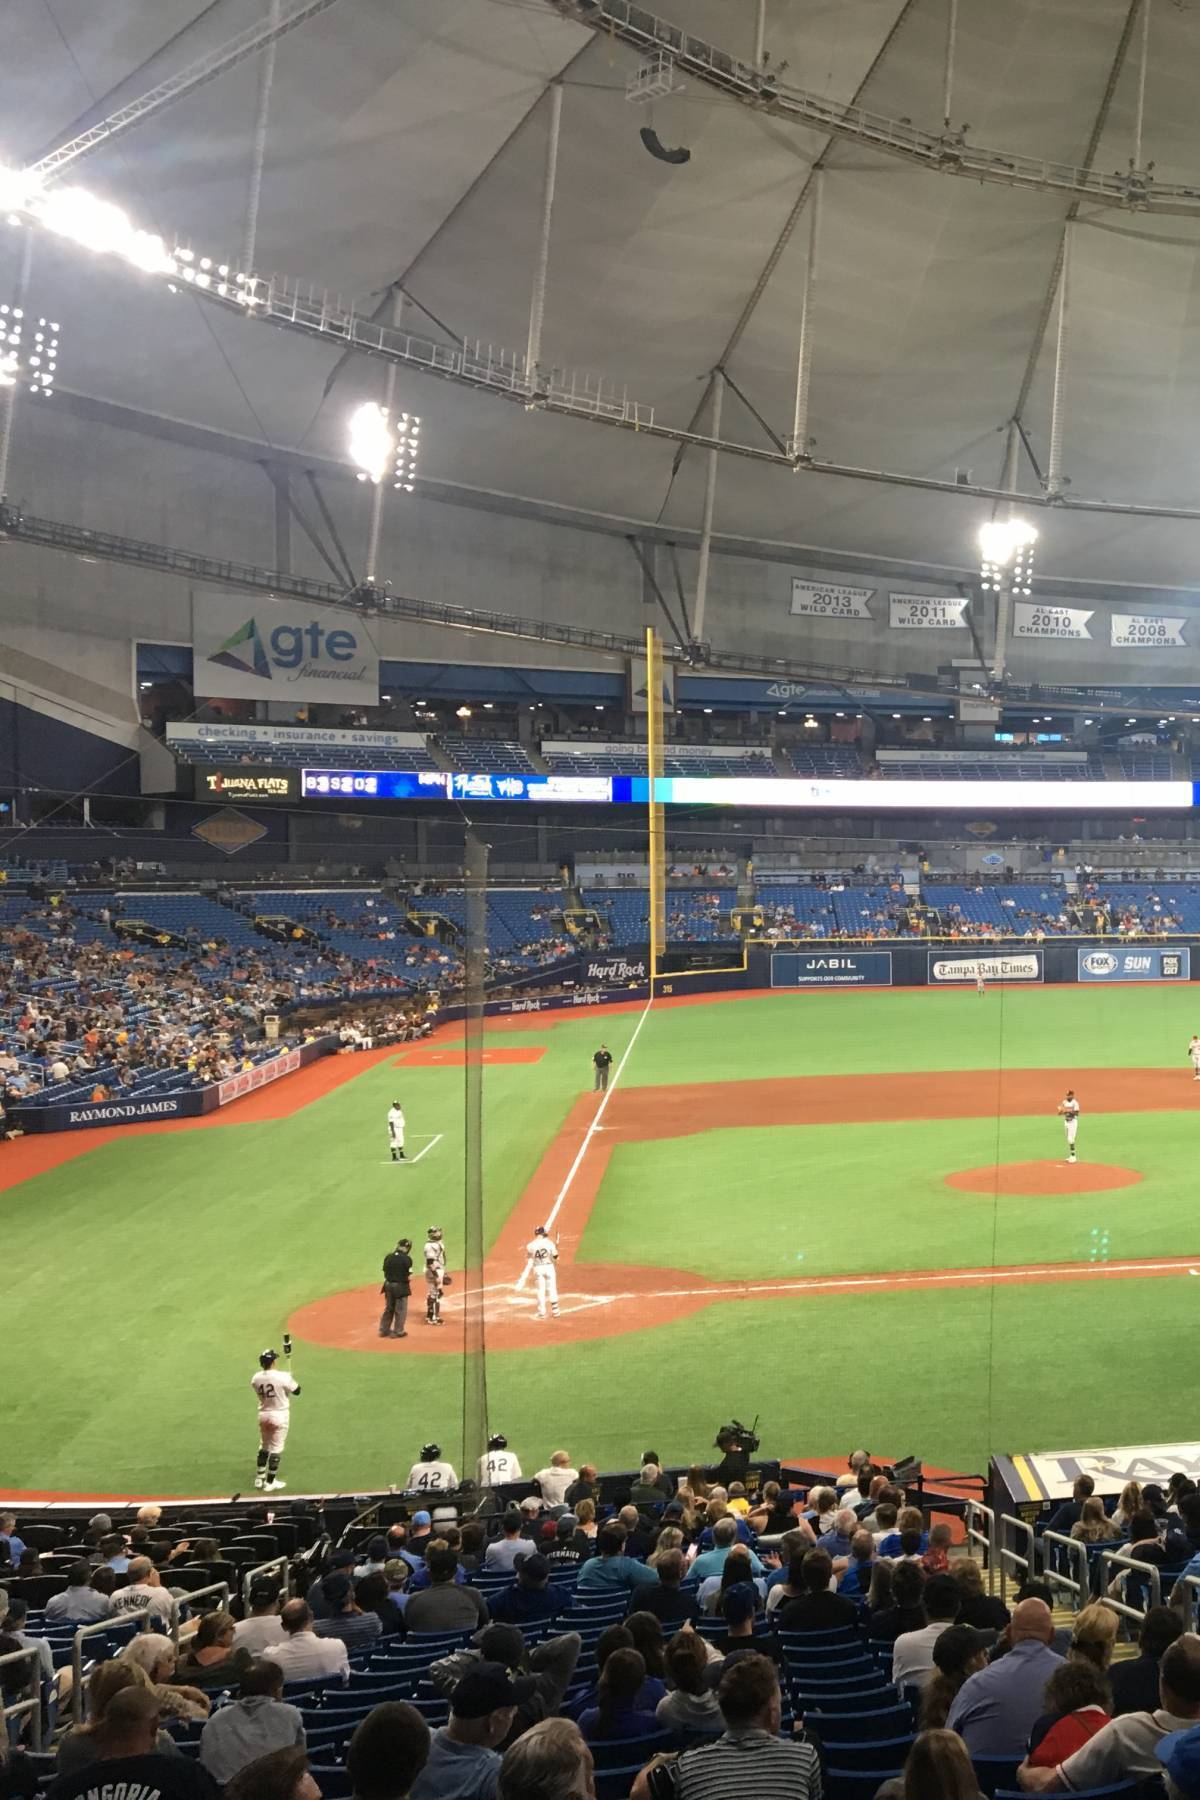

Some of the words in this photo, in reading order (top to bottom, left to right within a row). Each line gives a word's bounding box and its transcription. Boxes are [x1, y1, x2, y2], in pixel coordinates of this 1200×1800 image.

[795, 583, 836, 594] AMERICAN
[837, 588, 868, 597] LEAGUE
[812, 592, 852, 607] 2013
[892, 597, 931, 606] AMERICAN
[932, 599, 962, 607] LEAGUE
[800, 603, 827, 614] WILD
[831, 607, 861, 617] CARD
[909, 605, 946, 618] 2011
[897, 617, 924, 626] WILD
[928, 618, 957, 627] CARD
[1031, 614, 1071, 628] 2010
[1018, 626, 1082, 637] CHAMPIONS
[1128, 624, 1167, 636] 2008
[270, 620, 357, 669] gte
[1115, 636, 1177, 645] CHAMPIONS
[287, 662, 367, 682] financial
[781, 683, 806, 698] gte
[197, 726, 257, 741] checking
[273, 728, 336, 741] insurance
[351, 733, 399, 746] savings
[604, 743, 635, 755] going
[677, 745, 713, 757] money
[257, 777, 289, 790] FLATS
[806, 958, 857, 969] JABIL
[1090, 956, 1110, 966] FOX
[1124, 956, 1152, 970] SUN
[588, 962, 617, 978] Hard
[617, 962, 645, 977] Rock
[938, 962, 976, 977] Tampa
[976, 961, 999, 978] Bay
[1000, 960, 1034, 974] Times
[69, 1105, 136, 1123] RAYMOND
[137, 1100, 178, 1116] JAMES
[534, 1248, 548, 1259] 42
[257, 1383, 276, 1398] 42
[486, 1457, 508, 1473] 42
[418, 1471, 442, 1489] 42
